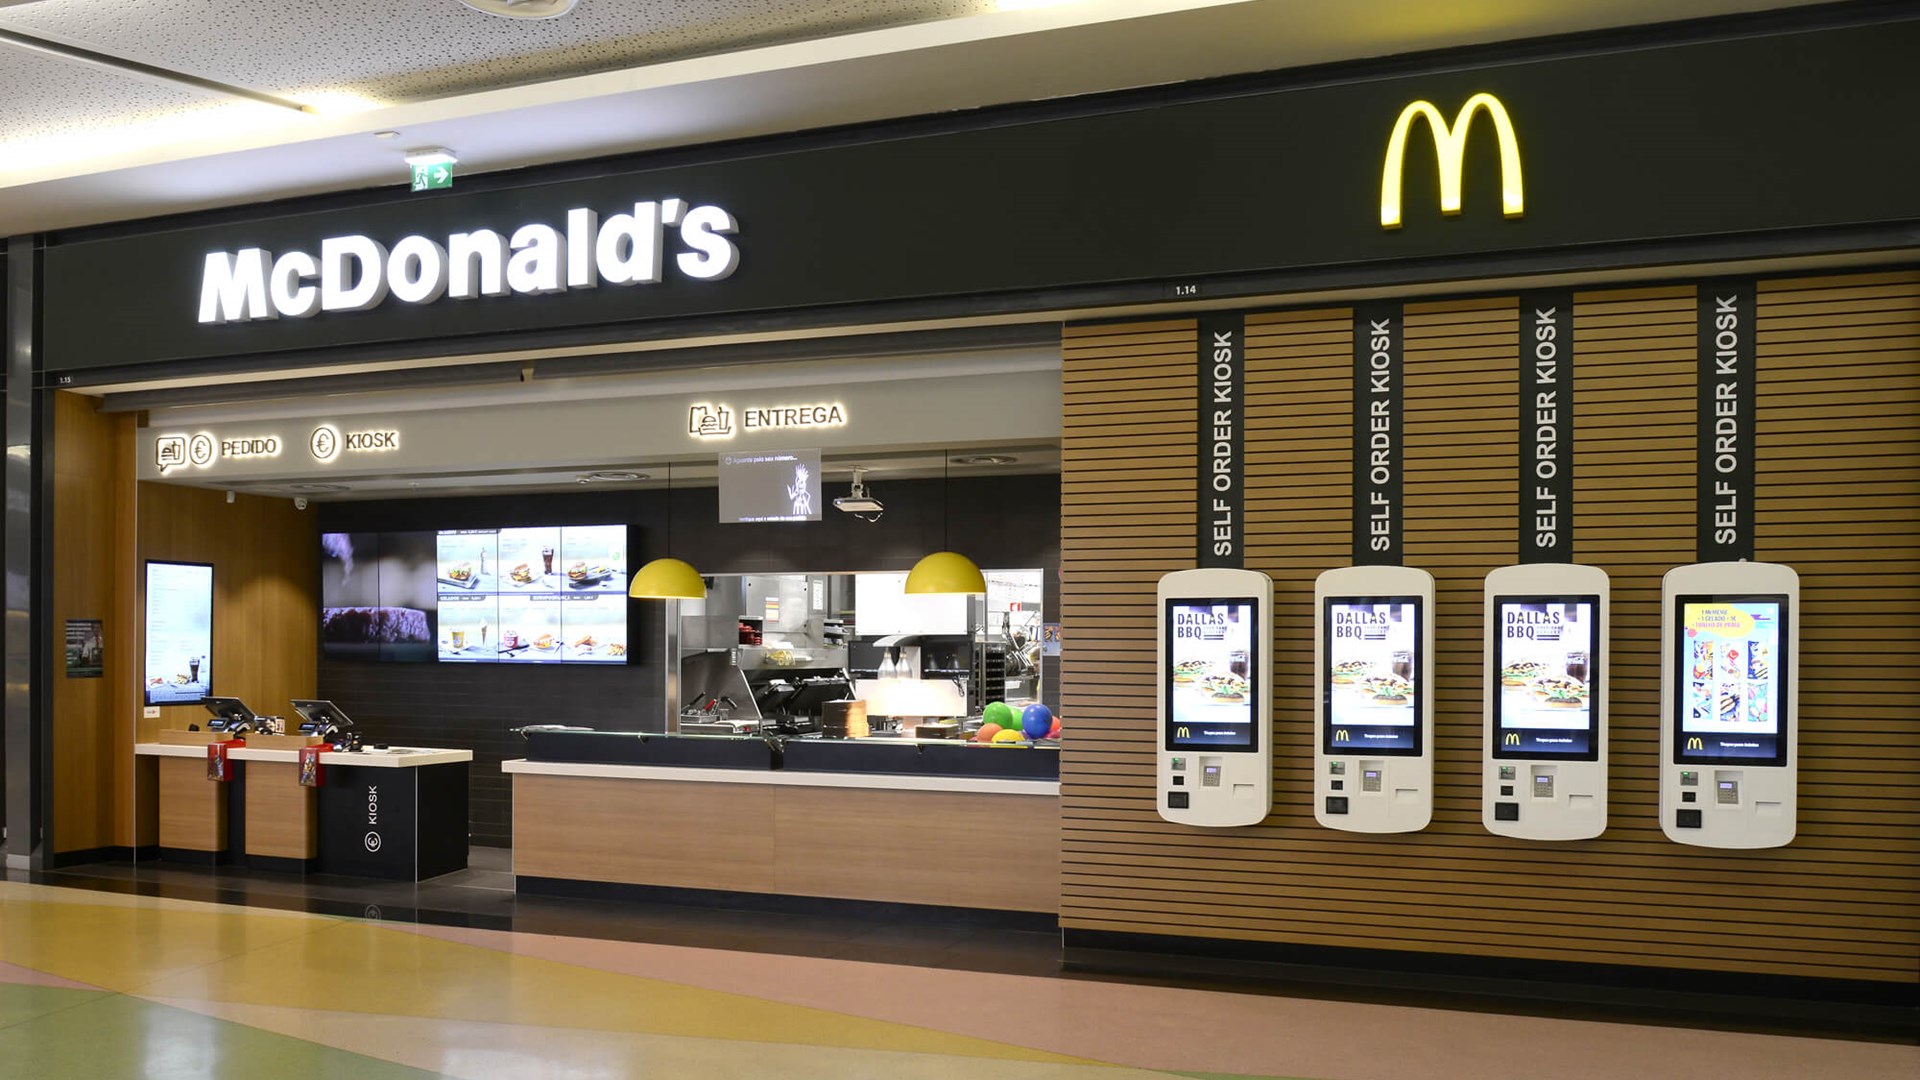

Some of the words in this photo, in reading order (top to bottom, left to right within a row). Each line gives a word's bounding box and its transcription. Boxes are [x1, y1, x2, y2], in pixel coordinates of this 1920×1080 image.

[198, 197, 740, 323] McDonald's
[1176, 285, 1197, 296] 1.14
[1370, 318, 1390, 393] KIOSK
[1536, 307, 1557, 384] KIOSK
[1715, 294, 1738, 375] KIOSK
[1213, 331, 1232, 403] KIOSK
[346, 432, 396, 450] KIOSK
[744, 406, 843, 428] ENTREGA
[1370, 399, 1390, 485] ORDER
[1536, 390, 1557, 479] ORDER
[1715, 381, 1738, 473] ORDER
[221, 438, 277, 456] PEDIDO
[1213, 409, 1232, 491] ORDER
[1213, 498, 1232, 556] SELF
[1370, 491, 1390, 552] SELF
[1536, 486, 1557, 548] SELF
[1715, 481, 1738, 545] SELF
[1177, 613, 1225, 625] DALLAS
[1177, 626, 1202, 640] BBQ
[1336, 612, 1386, 624] DALLAS
[1336, 626, 1362, 640] BBQ
[1507, 611, 1560, 624] DALLAS
[1507, 626, 1534, 640] BBQ
[368, 785, 378, 825] KIOSK
